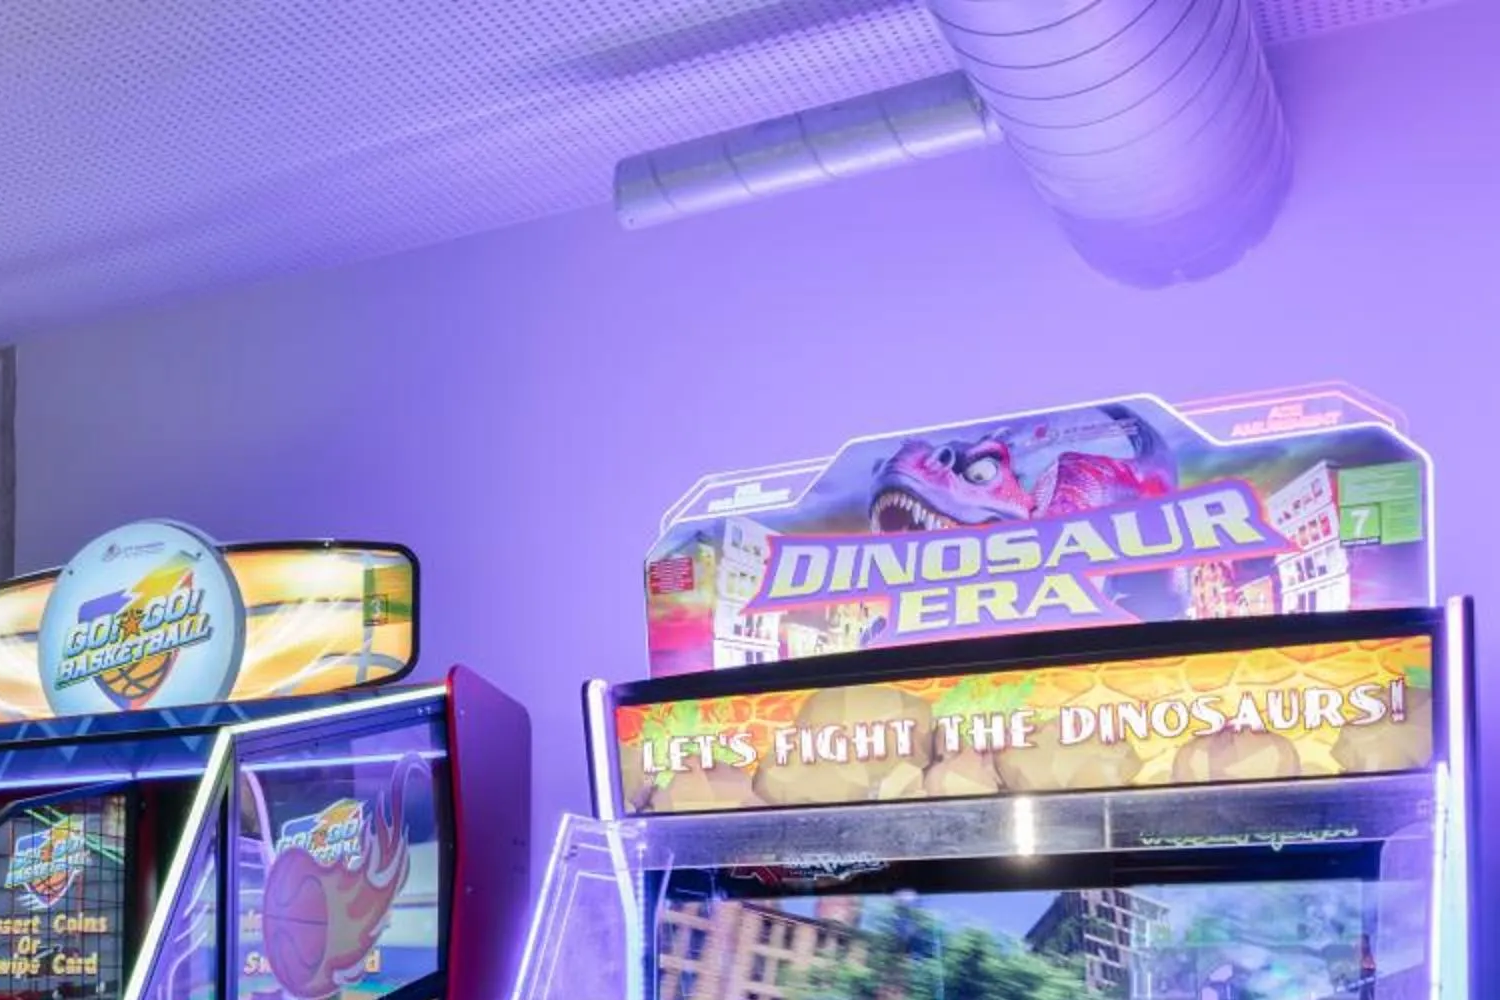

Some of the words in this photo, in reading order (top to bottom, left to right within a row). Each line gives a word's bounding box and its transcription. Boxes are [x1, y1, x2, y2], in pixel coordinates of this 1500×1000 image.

[767, 487, 1267, 599] DINOSAUR
[895, 572, 1099, 634] ERA
[55, 612, 213, 690] BASKETBALL
[641, 730, 757, 774] LET'S
[773, 718, 916, 767] FIGHT
[937, 708, 1038, 754] THE
[1059, 678, 1407, 746] DINOSAURS!
